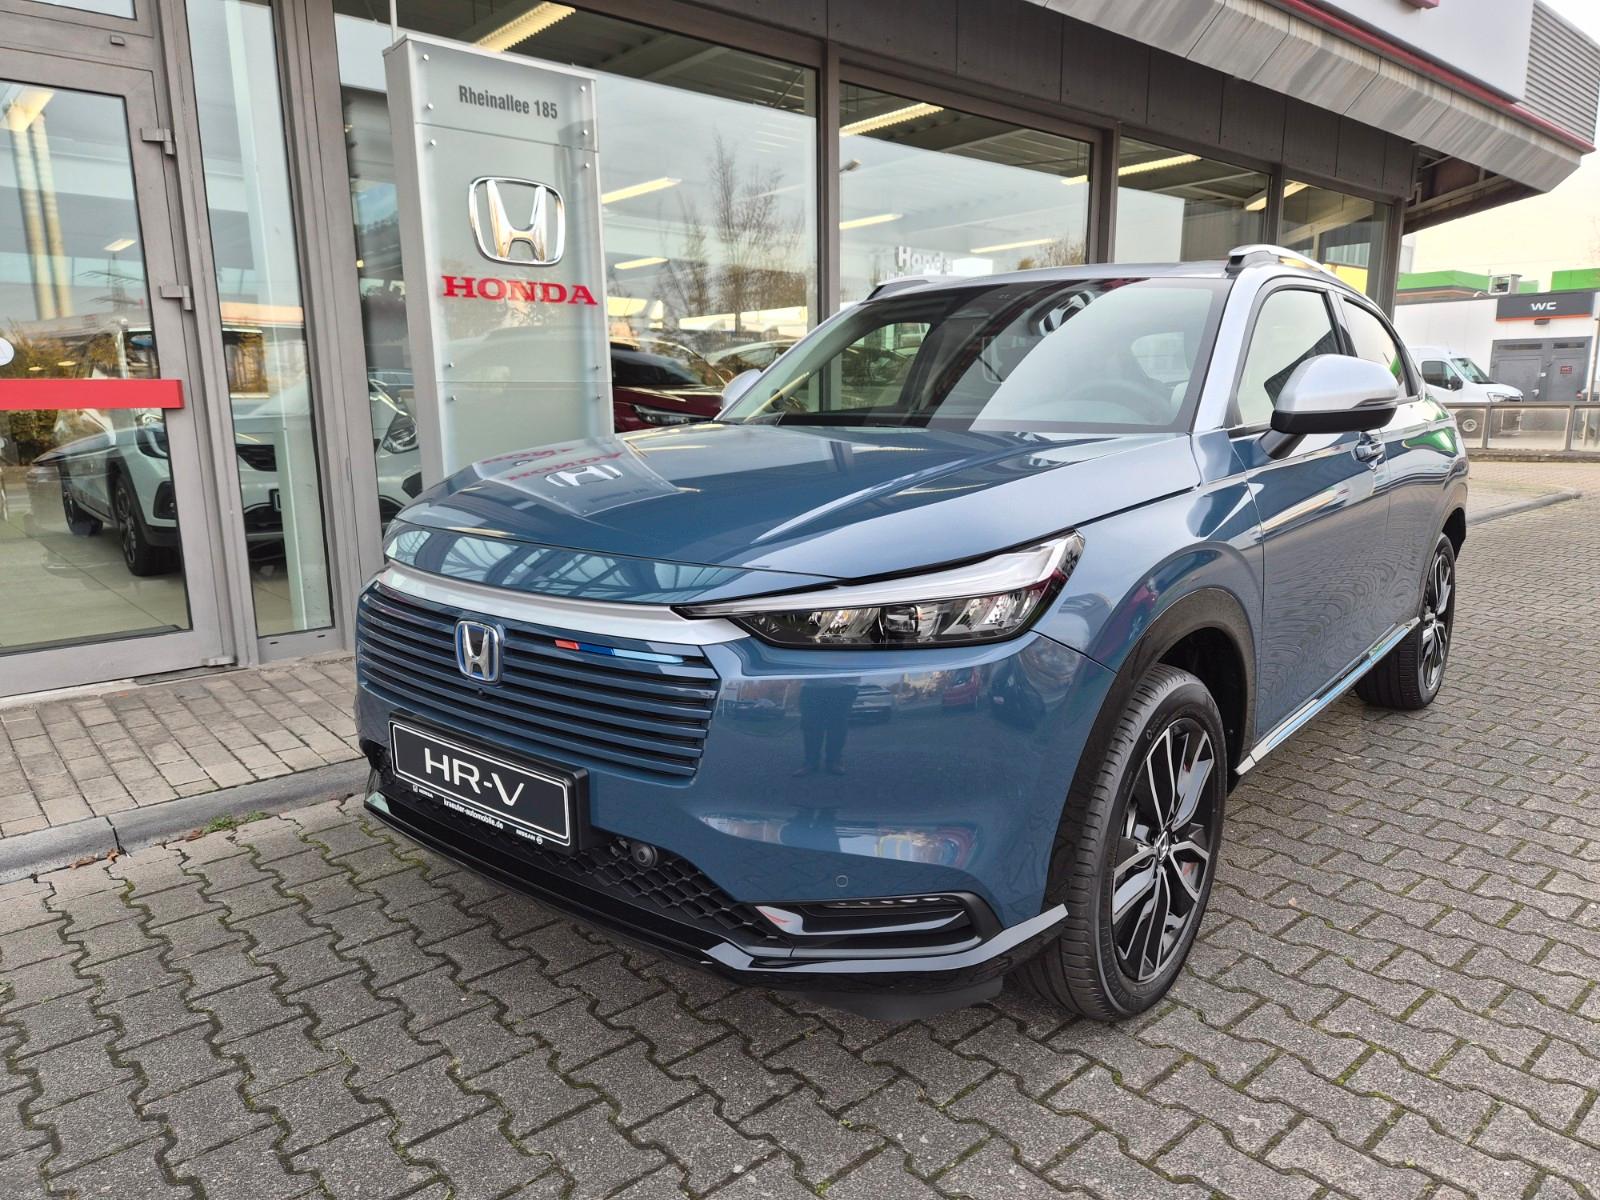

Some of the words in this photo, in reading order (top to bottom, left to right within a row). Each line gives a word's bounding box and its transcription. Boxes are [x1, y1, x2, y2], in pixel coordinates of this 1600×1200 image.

[458, 85, 530, 115] Rheinallee
[534, 99, 558, 120] 185
[441, 275, 599, 307] HONDA
[1530, 301, 1557, 312] WC
[423, 747, 525, 807] HR-V
